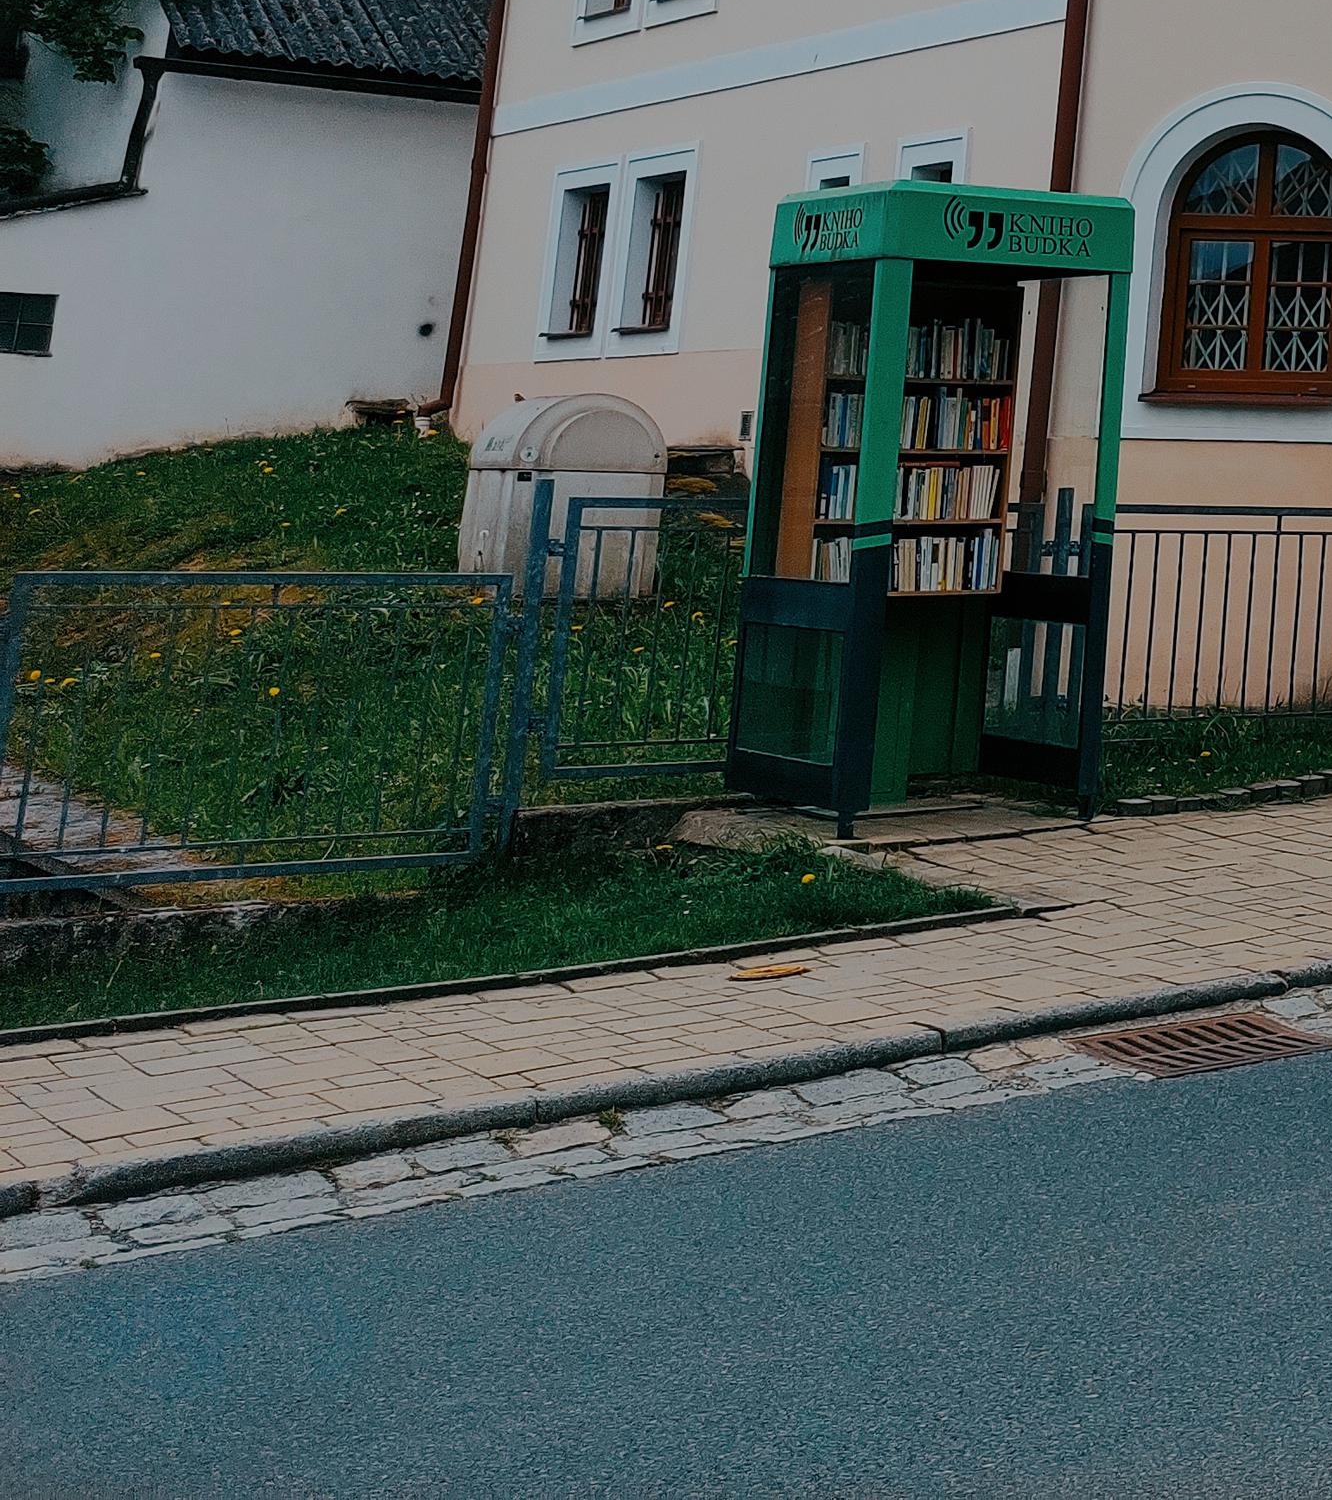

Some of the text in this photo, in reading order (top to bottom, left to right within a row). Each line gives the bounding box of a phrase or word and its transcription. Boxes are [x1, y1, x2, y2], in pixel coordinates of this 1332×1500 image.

[821, 208, 863, 232] KNIHO
[1008, 213, 1093, 238] KNIHO
[819, 230, 859, 252] BUDKA
[1008, 234, 1092, 257] BUDKA
